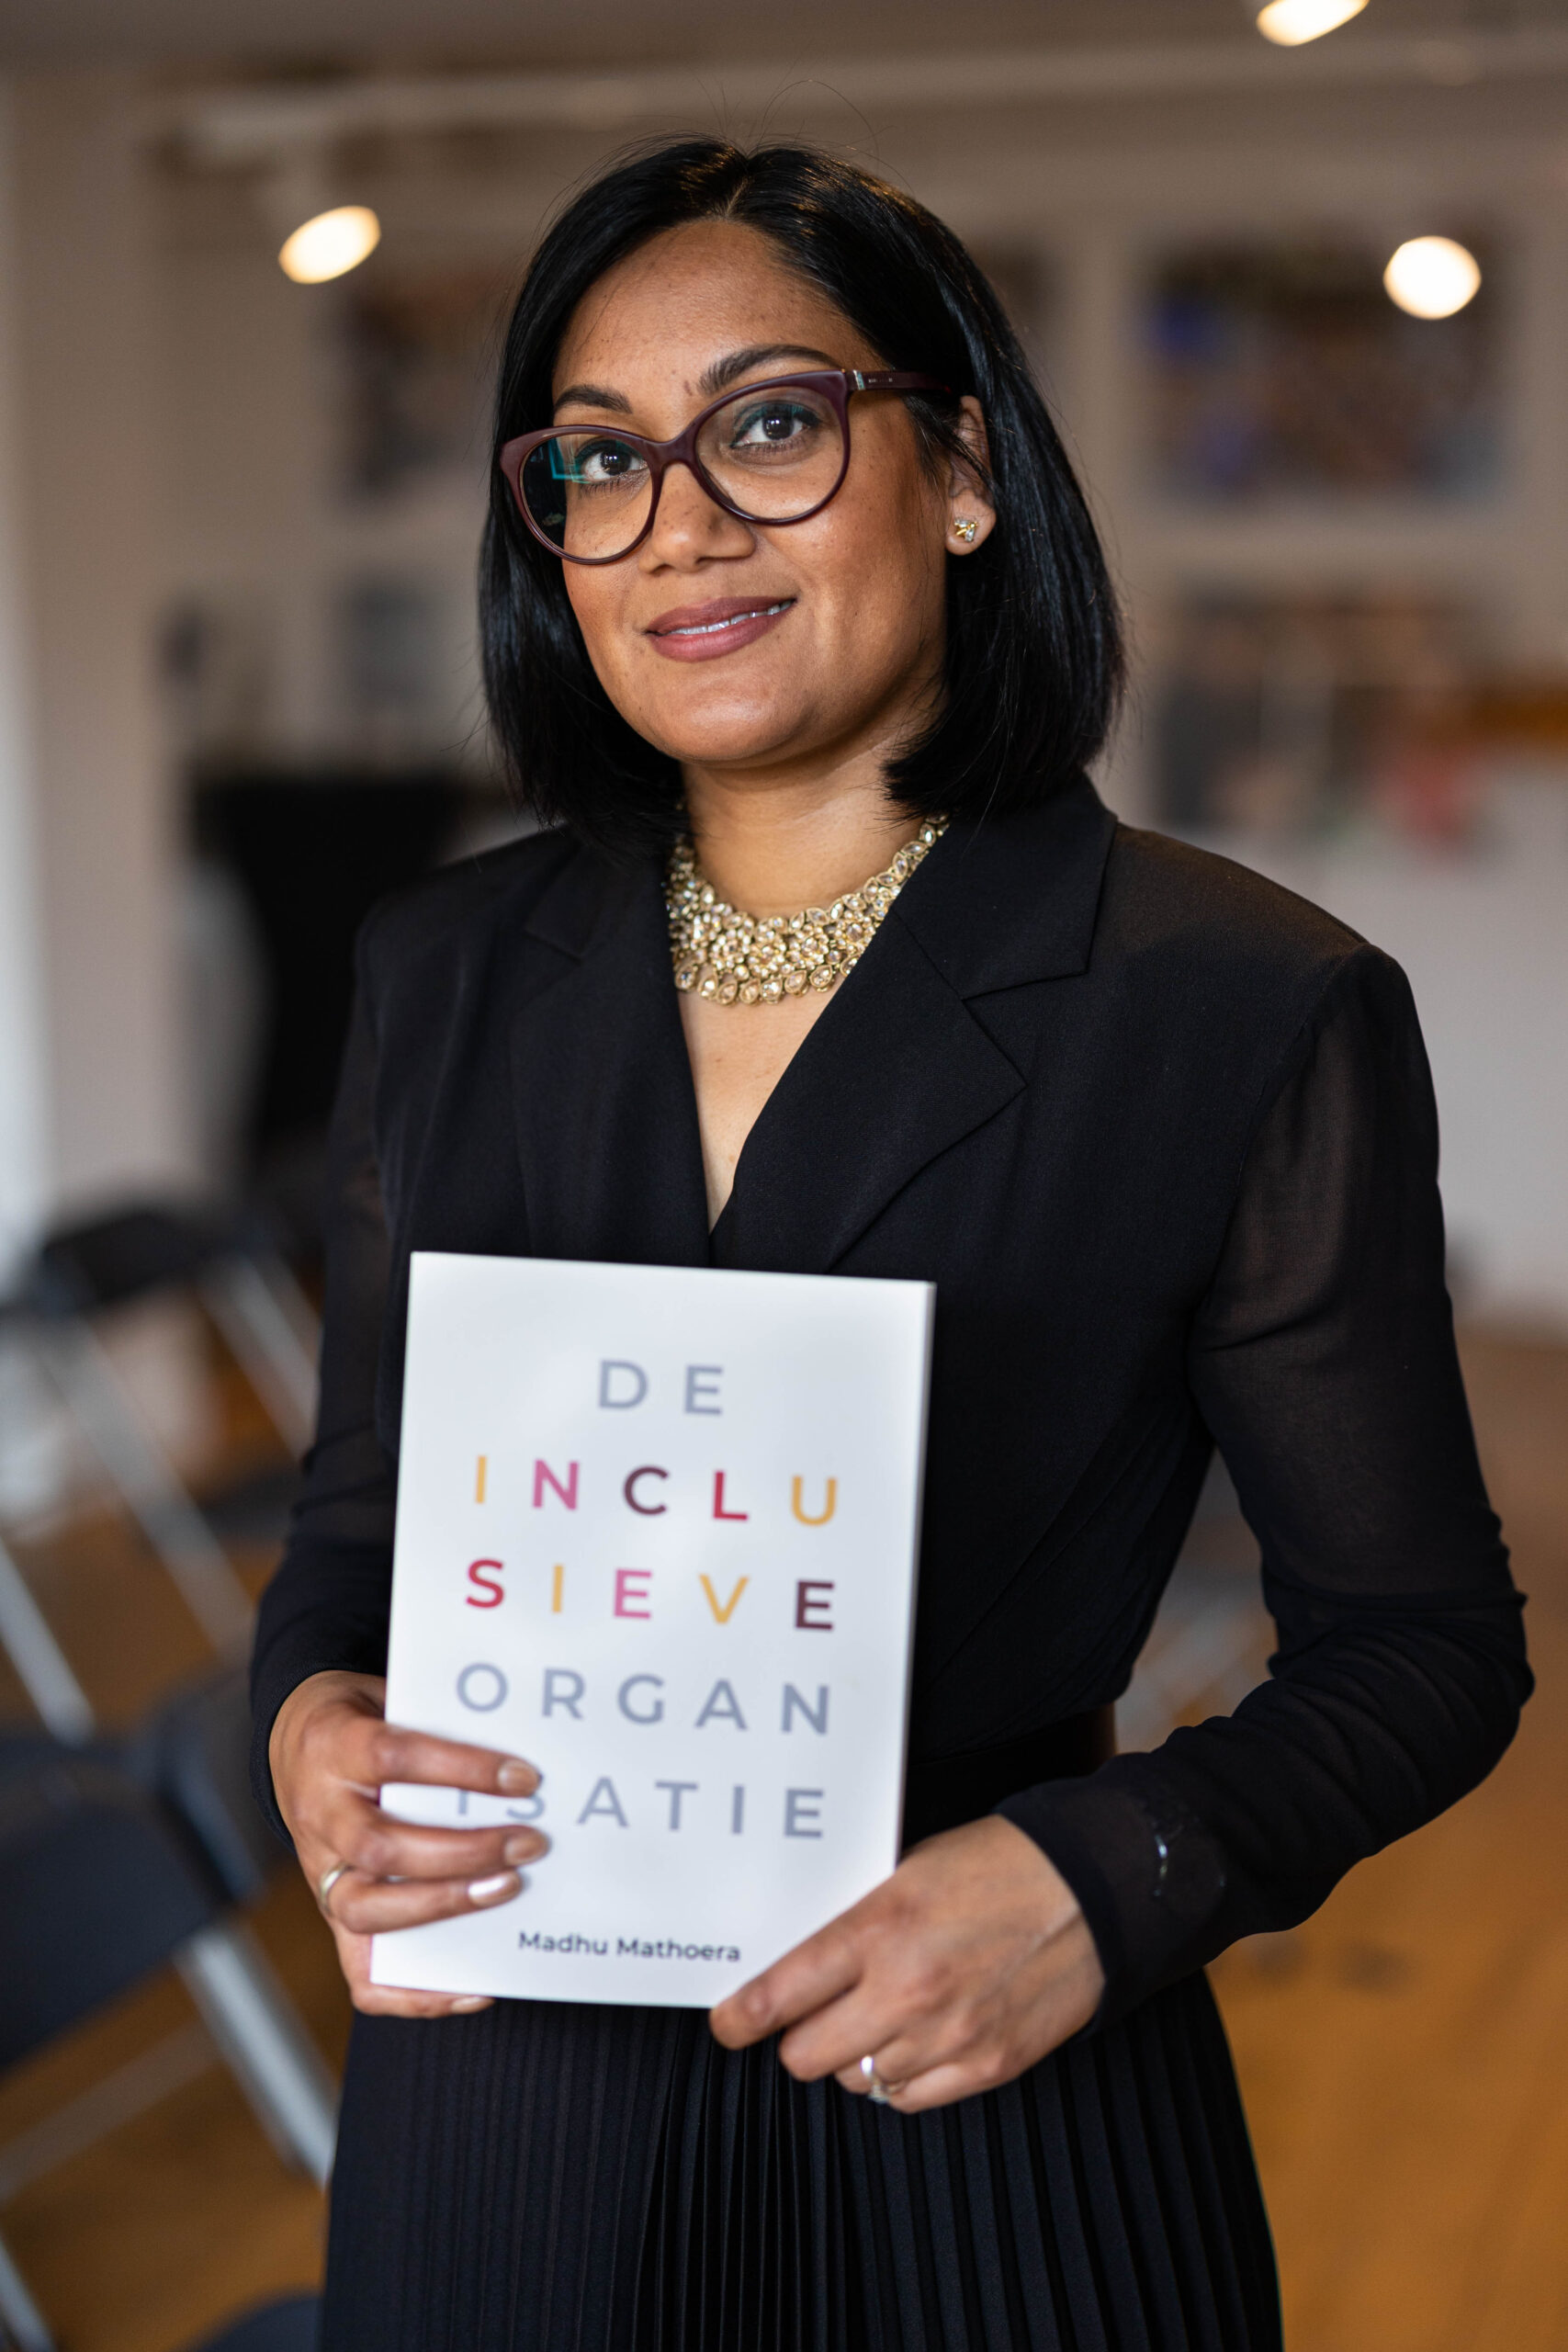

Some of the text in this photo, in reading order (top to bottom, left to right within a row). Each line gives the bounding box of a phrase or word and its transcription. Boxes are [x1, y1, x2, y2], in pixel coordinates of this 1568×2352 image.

[597, 1359, 724, 1416] DE
[475, 1455, 837, 1527] INCLU
[466, 1558, 835, 1631] SIEVE
[456, 1662, 829, 1736] ORGAN
[518, 1931, 740, 1962] Madhu Mathoera
